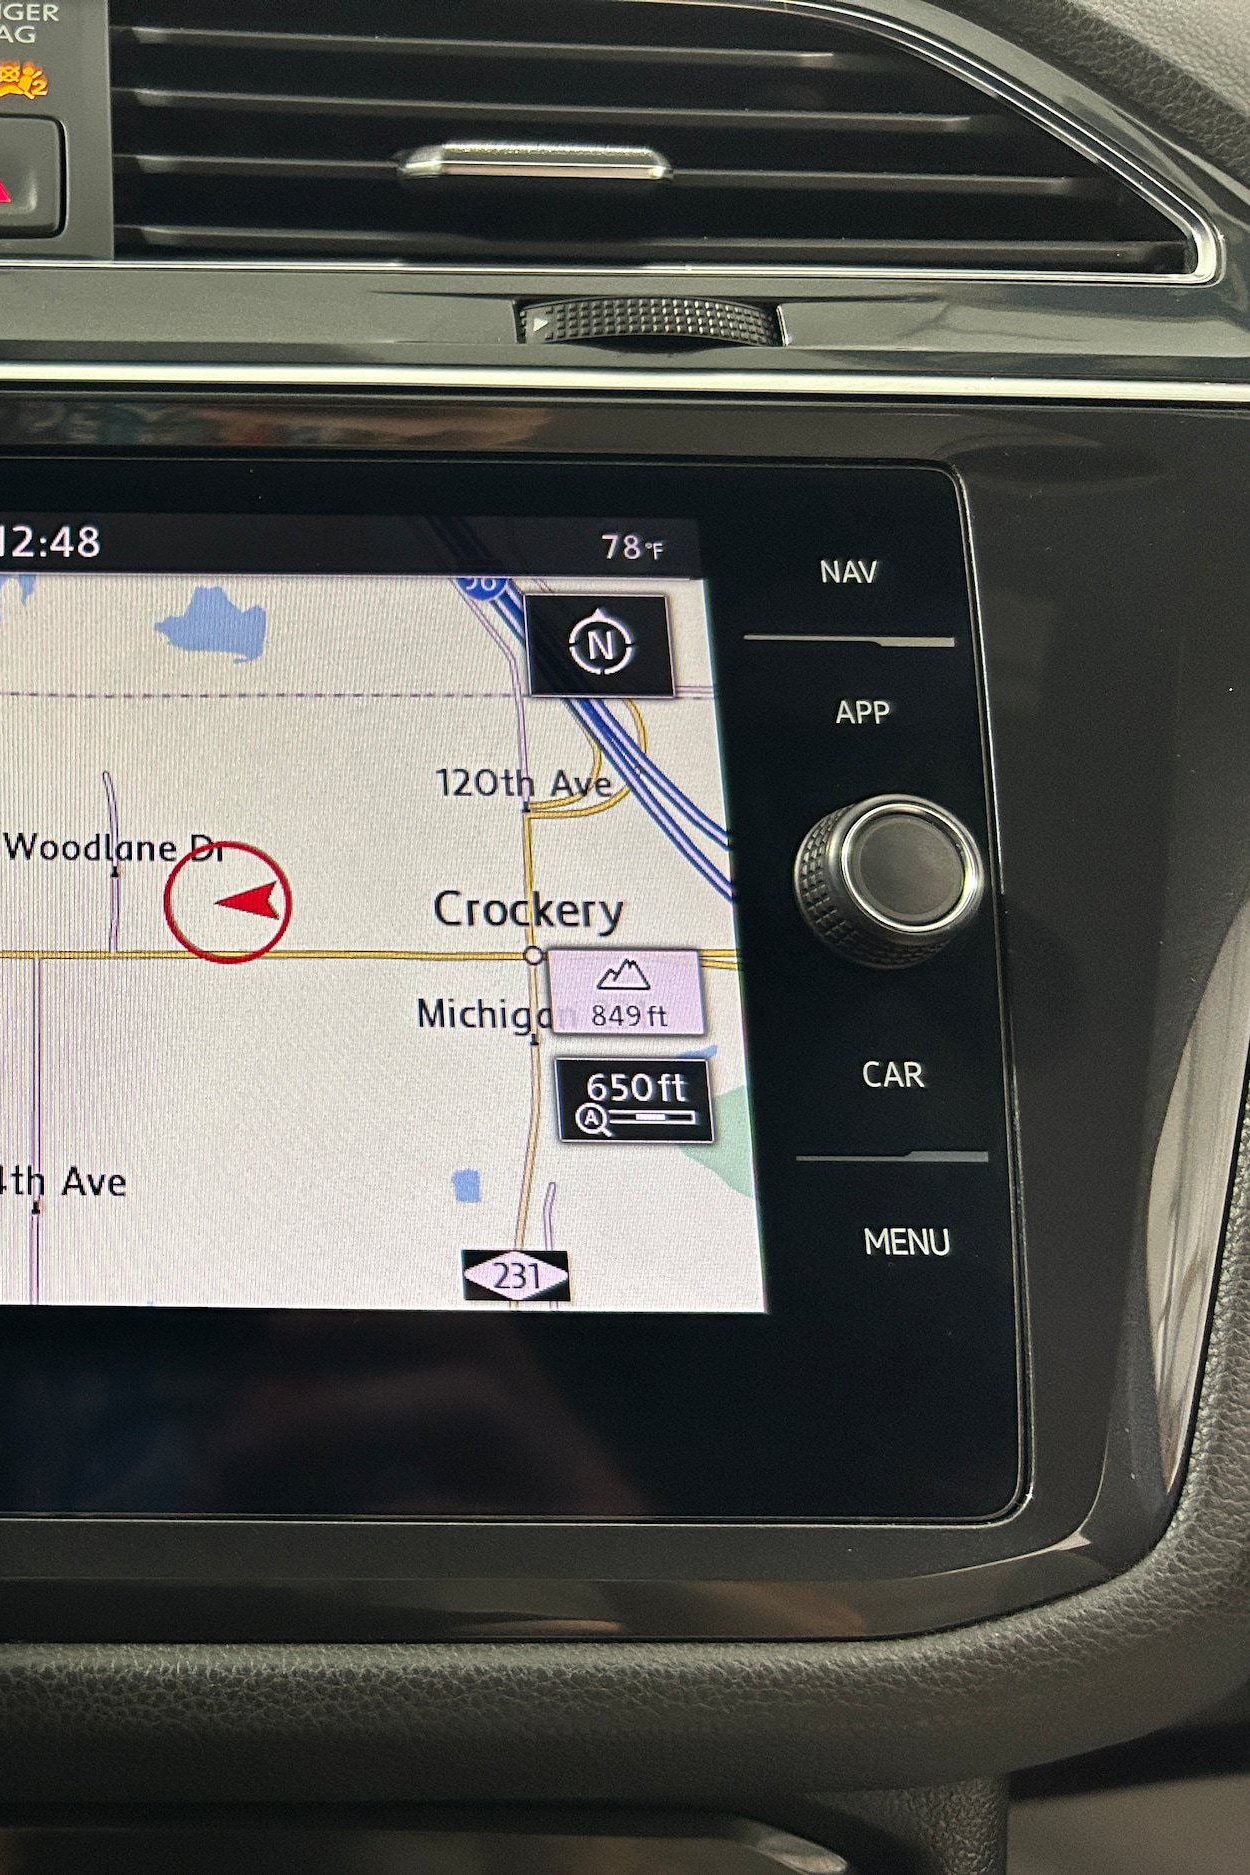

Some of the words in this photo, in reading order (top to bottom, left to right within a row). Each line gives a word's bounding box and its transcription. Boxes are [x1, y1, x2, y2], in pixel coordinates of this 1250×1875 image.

[820, 560, 878, 584] NAV
[587, 630, 615, 661] N
[835, 700, 891, 725] APP
[436, 768, 535, 798] 120th
[551, 770, 613, 798] Ave
[3, 832, 177, 862] Woodlane
[190, 835, 225, 863] Dr
[434, 889, 624, 937] Crockery
[591, 1005, 641, 1027] 849
[646, 1004, 668, 1027] ft
[587, 1073, 653, 1102] 650
[658, 1073, 687, 1102] ft
[862, 1060, 925, 1088] CAR
[61, 1165, 127, 1197] Ave
[863, 1227, 951, 1257] MENU
[492, 1262, 543, 1290] 231
